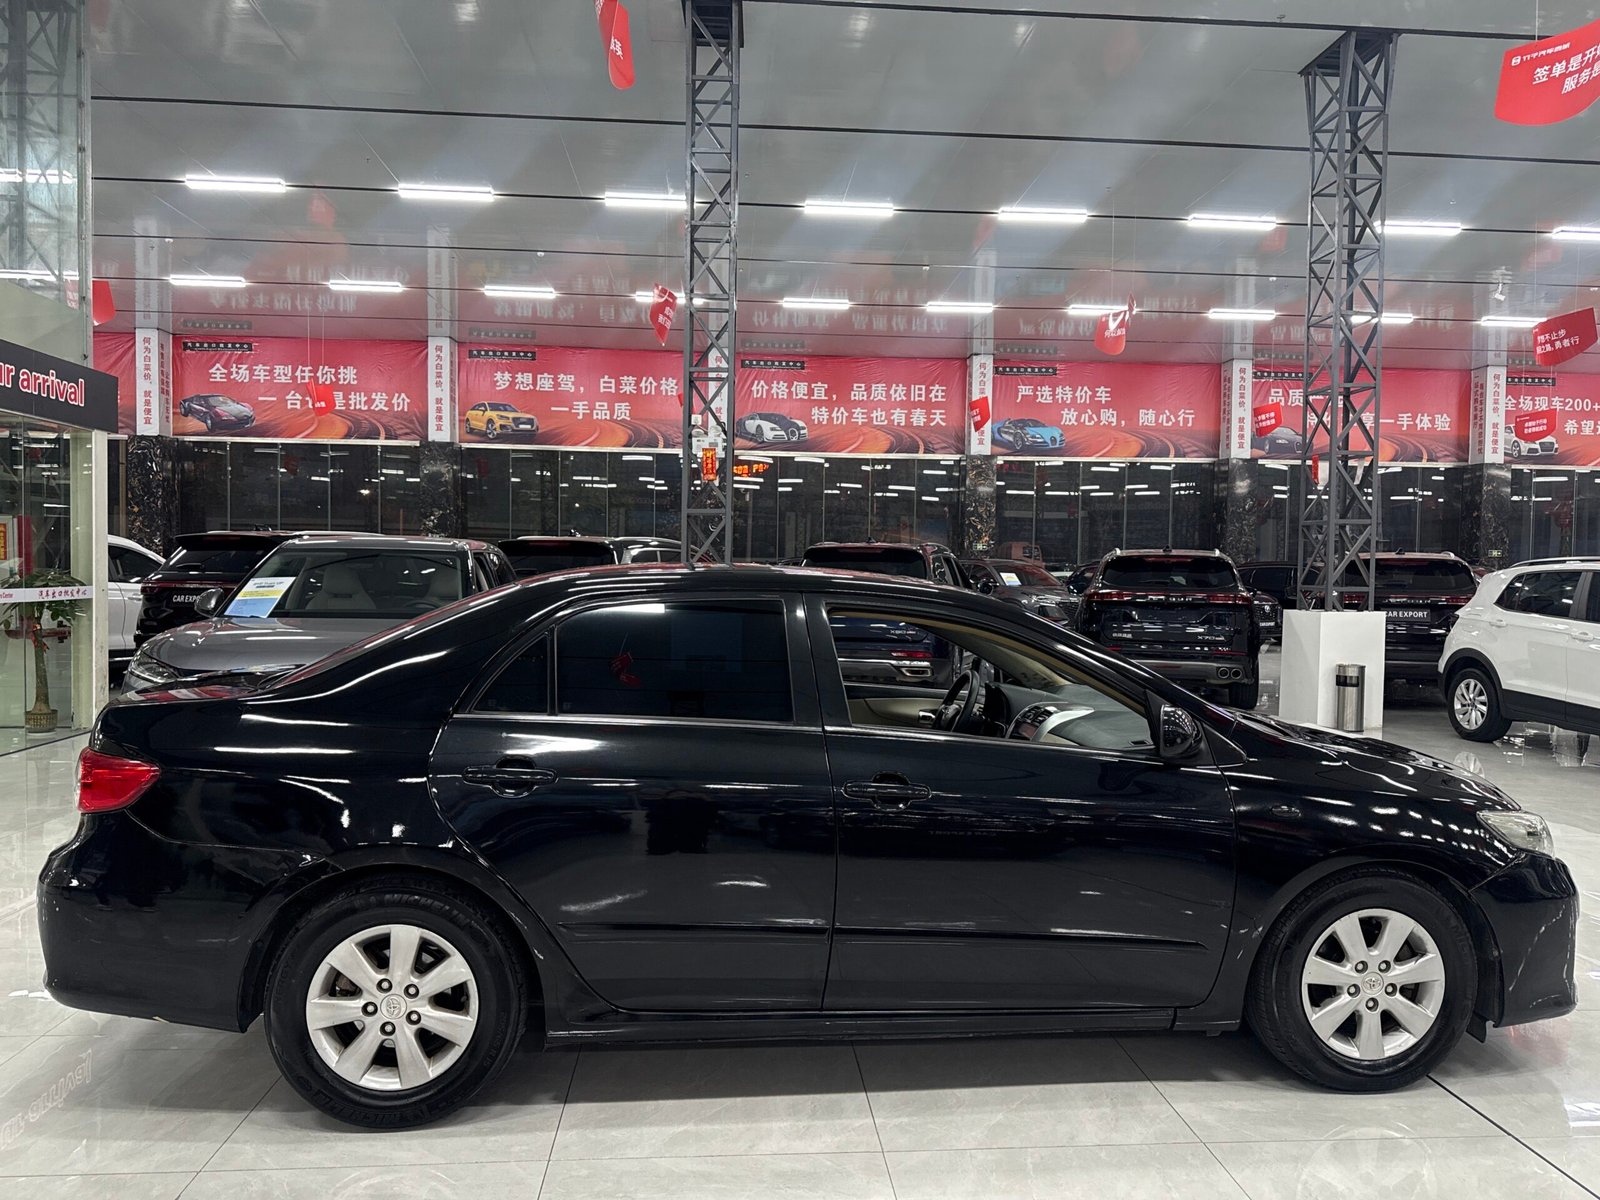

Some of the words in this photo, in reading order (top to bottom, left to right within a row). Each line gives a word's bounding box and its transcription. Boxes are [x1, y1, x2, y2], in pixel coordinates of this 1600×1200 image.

[208, 362, 358, 385] 全场车型任你挑
[493, 371, 679, 396] 梦想座驾，白菜价格
[0, 362, 15, 388] r
[19, 368, 85, 407] arrival
[751, 380, 947, 402] 价格便宜，品质依旧在
[1016, 385, 1112, 404] 严选特价车
[551, 401, 631, 421] 一手品质
[811, 406, 947, 427] 特价车也有春天
[1060, 408, 1195, 427] 放心购，随心行
